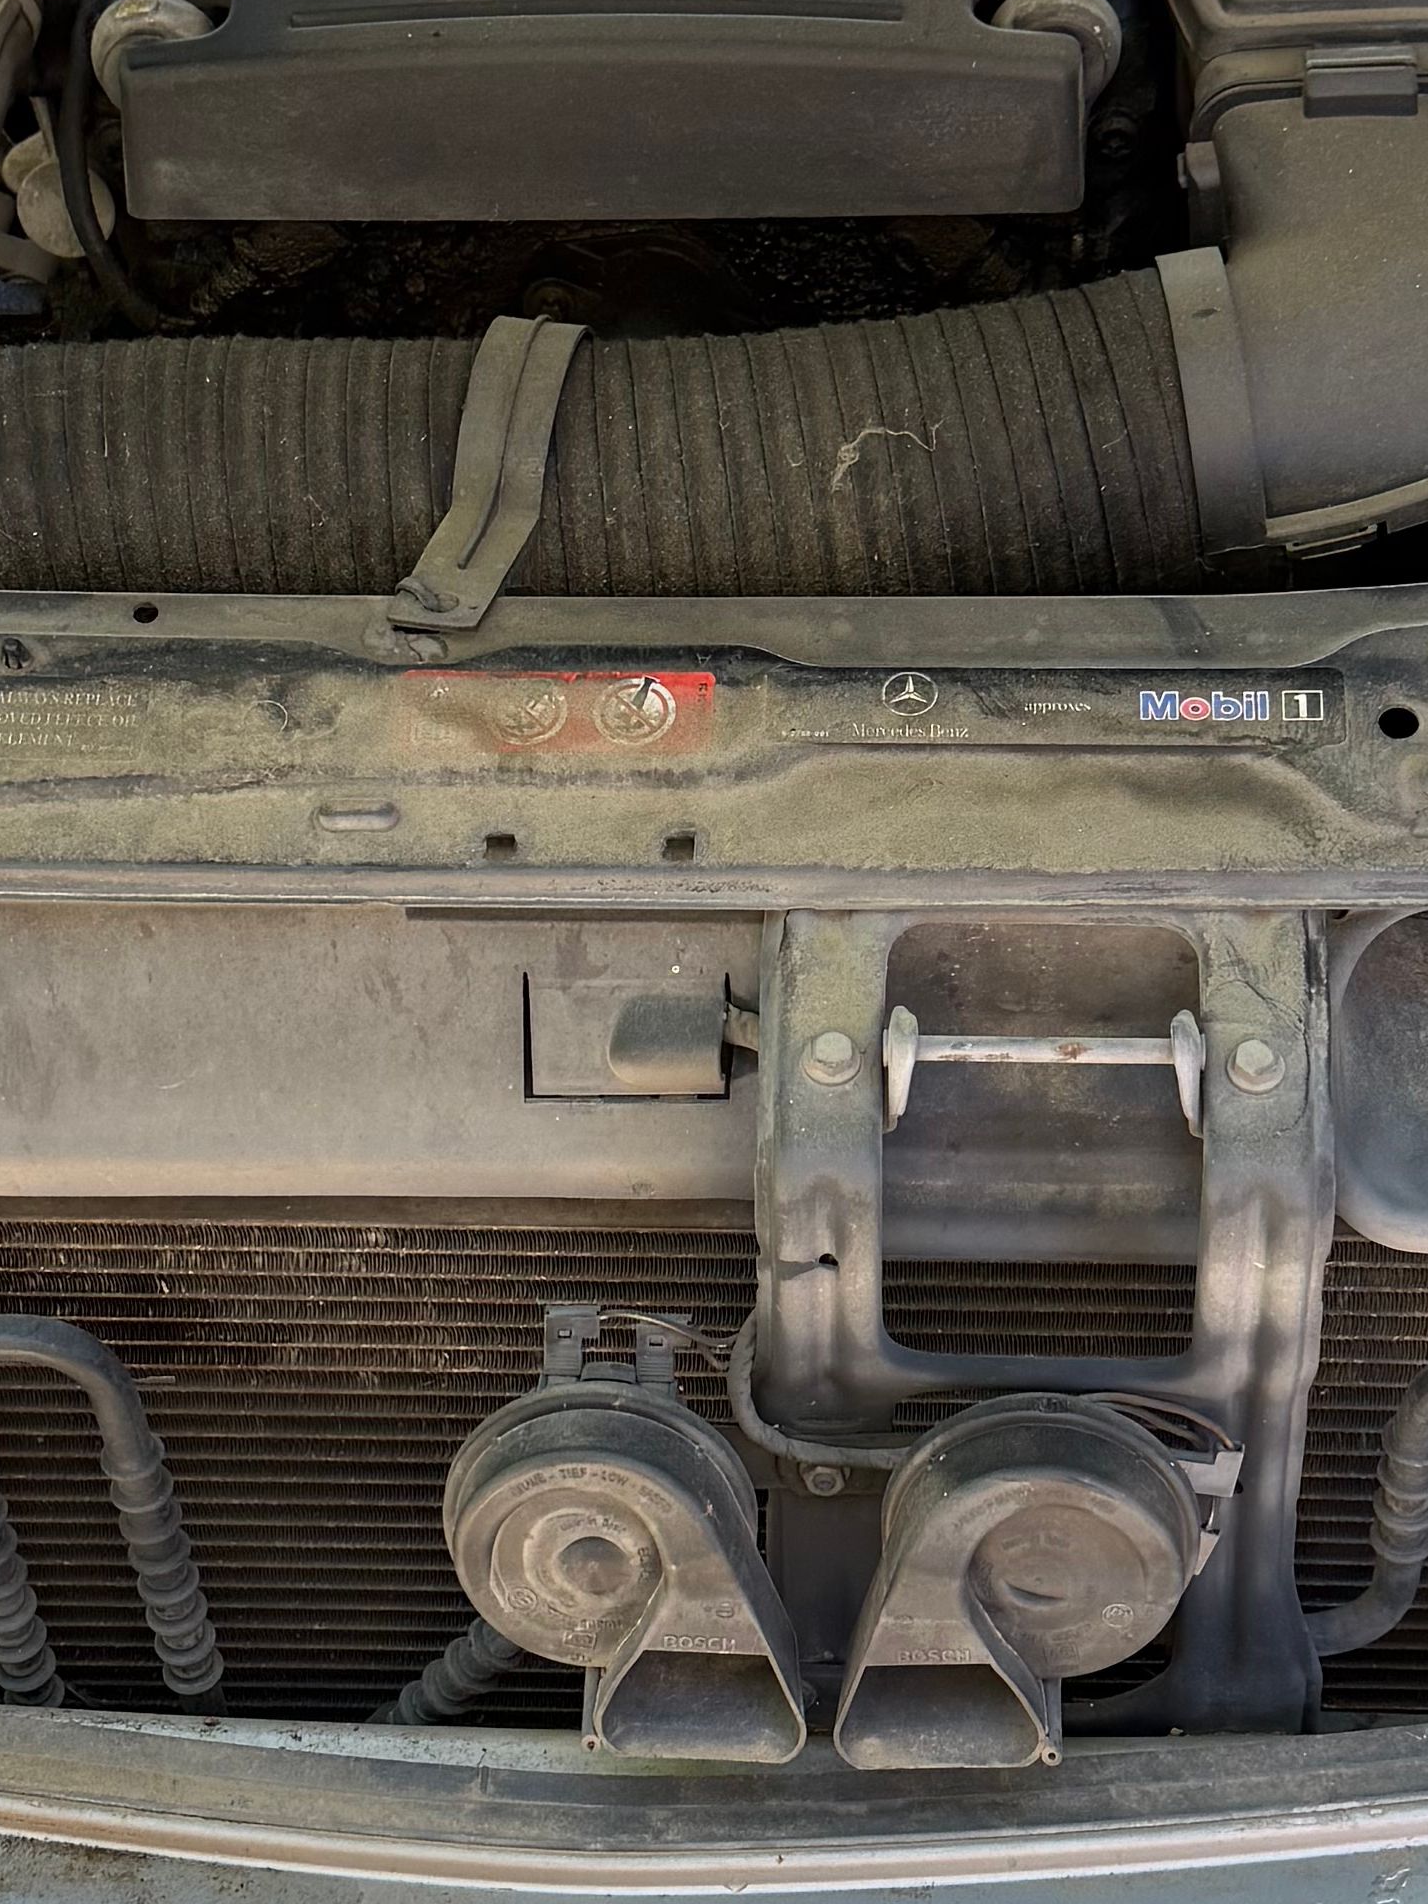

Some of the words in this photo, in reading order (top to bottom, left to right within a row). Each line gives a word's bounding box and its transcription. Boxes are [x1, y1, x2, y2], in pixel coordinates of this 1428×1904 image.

[1139, 690, 1269, 721] Mobil
[663, 1634, 736, 1651] BOSCH
[897, 1648, 971, 1665] BOSCH
